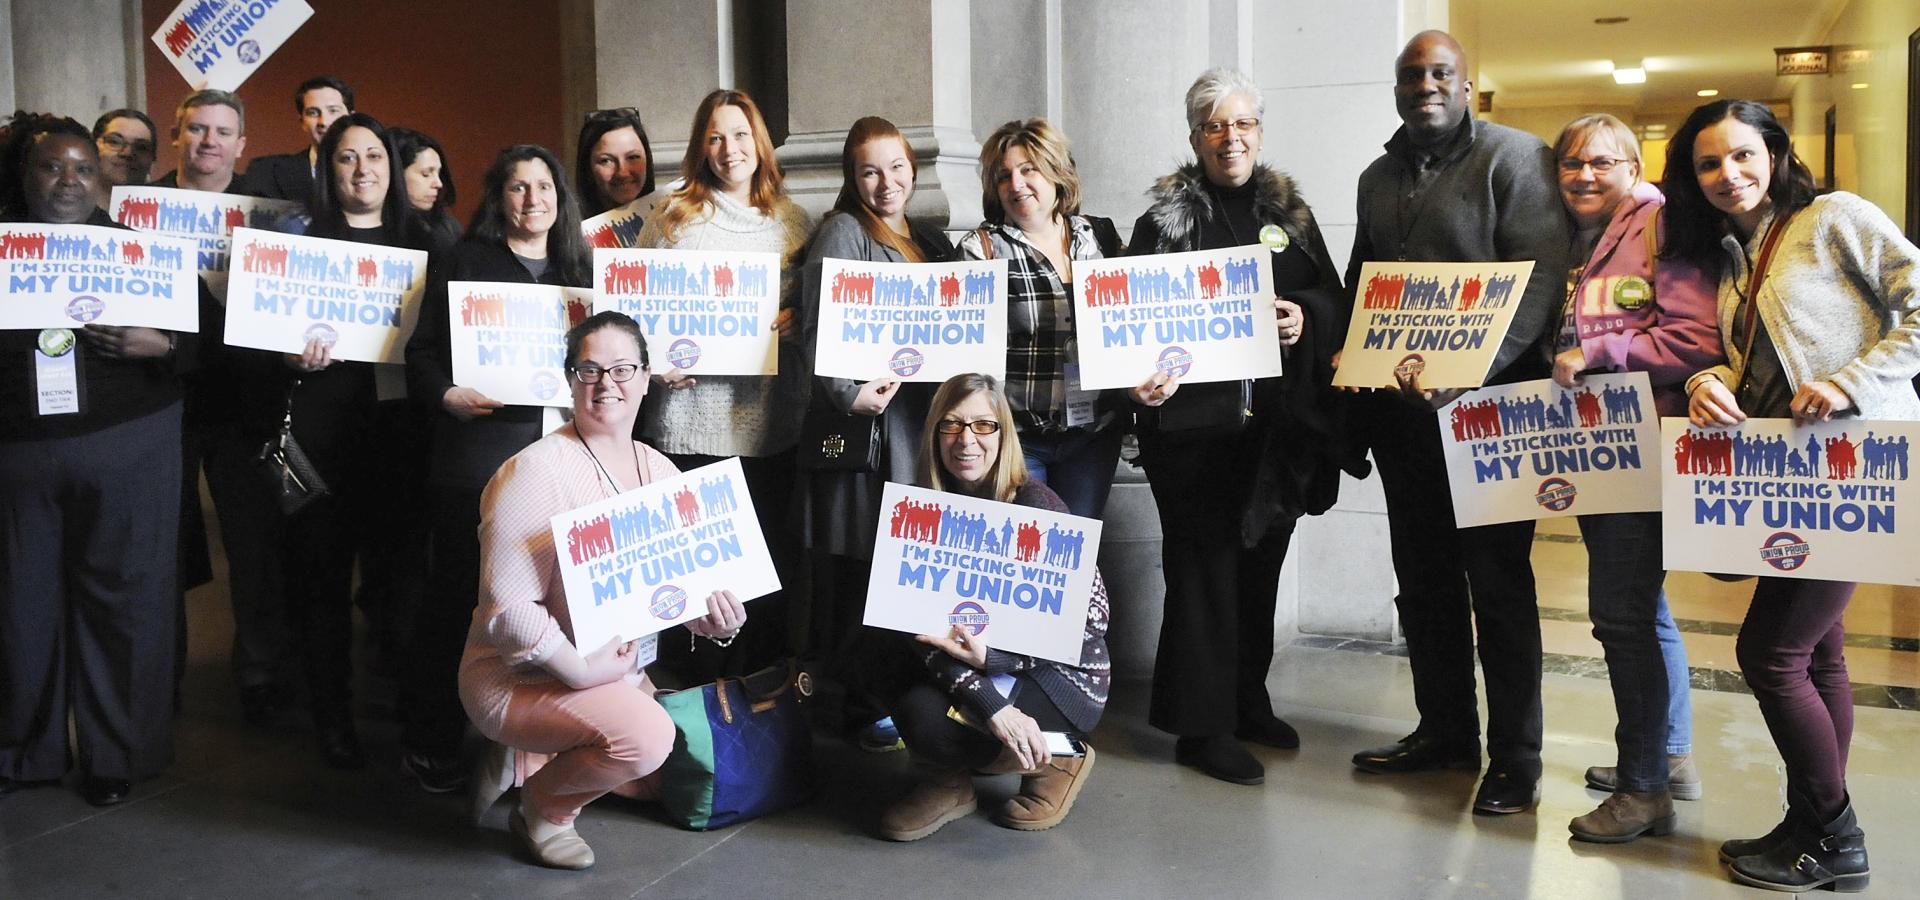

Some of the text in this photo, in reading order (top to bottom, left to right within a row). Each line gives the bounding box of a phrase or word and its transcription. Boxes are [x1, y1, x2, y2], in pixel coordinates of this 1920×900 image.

[187, 4, 242, 60] I'M STICKING
[194, 43, 222, 74] MY
[11, 263, 173, 281] I'M STICKING WITH
[9, 275, 173, 299] MY UNION
[256, 278, 403, 305] I'M STICKING WITH
[253, 292, 402, 327] MY UNION
[618, 300, 758, 313] I'M STICKING WITH
[843, 307, 985, 322] I'M STICKING WITH
[1101, 299, 1251, 323] I'M STICKING WITH
[669, 315, 758, 337] UNION
[1102, 314, 1254, 348] MY UNION
[1370, 313, 1494, 327] I'M STICKING WITH
[477, 330, 501, 343] I'M
[842, 321, 984, 345] MY UNION
[1363, 328, 1488, 351] MY UNION
[478, 345, 521, 367] MY
[1471, 428, 1637, 457] I'M STICKING WITH
[1474, 444, 1642, 484] MY UNION
[1694, 479, 1896, 502] I'M STICKING WITH
[1695, 498, 1896, 534] MY UNION
[588, 518, 735, 580] I'M STICKING WITH
[1760, 543, 1810, 559] UNION PROUD
[592, 534, 743, 607] MY UNION
[901, 544, 1067, 588] I'M STICKING WITH
[898, 561, 1064, 616] MY UNION
[949, 614, 990, 624] UNION PROUD
